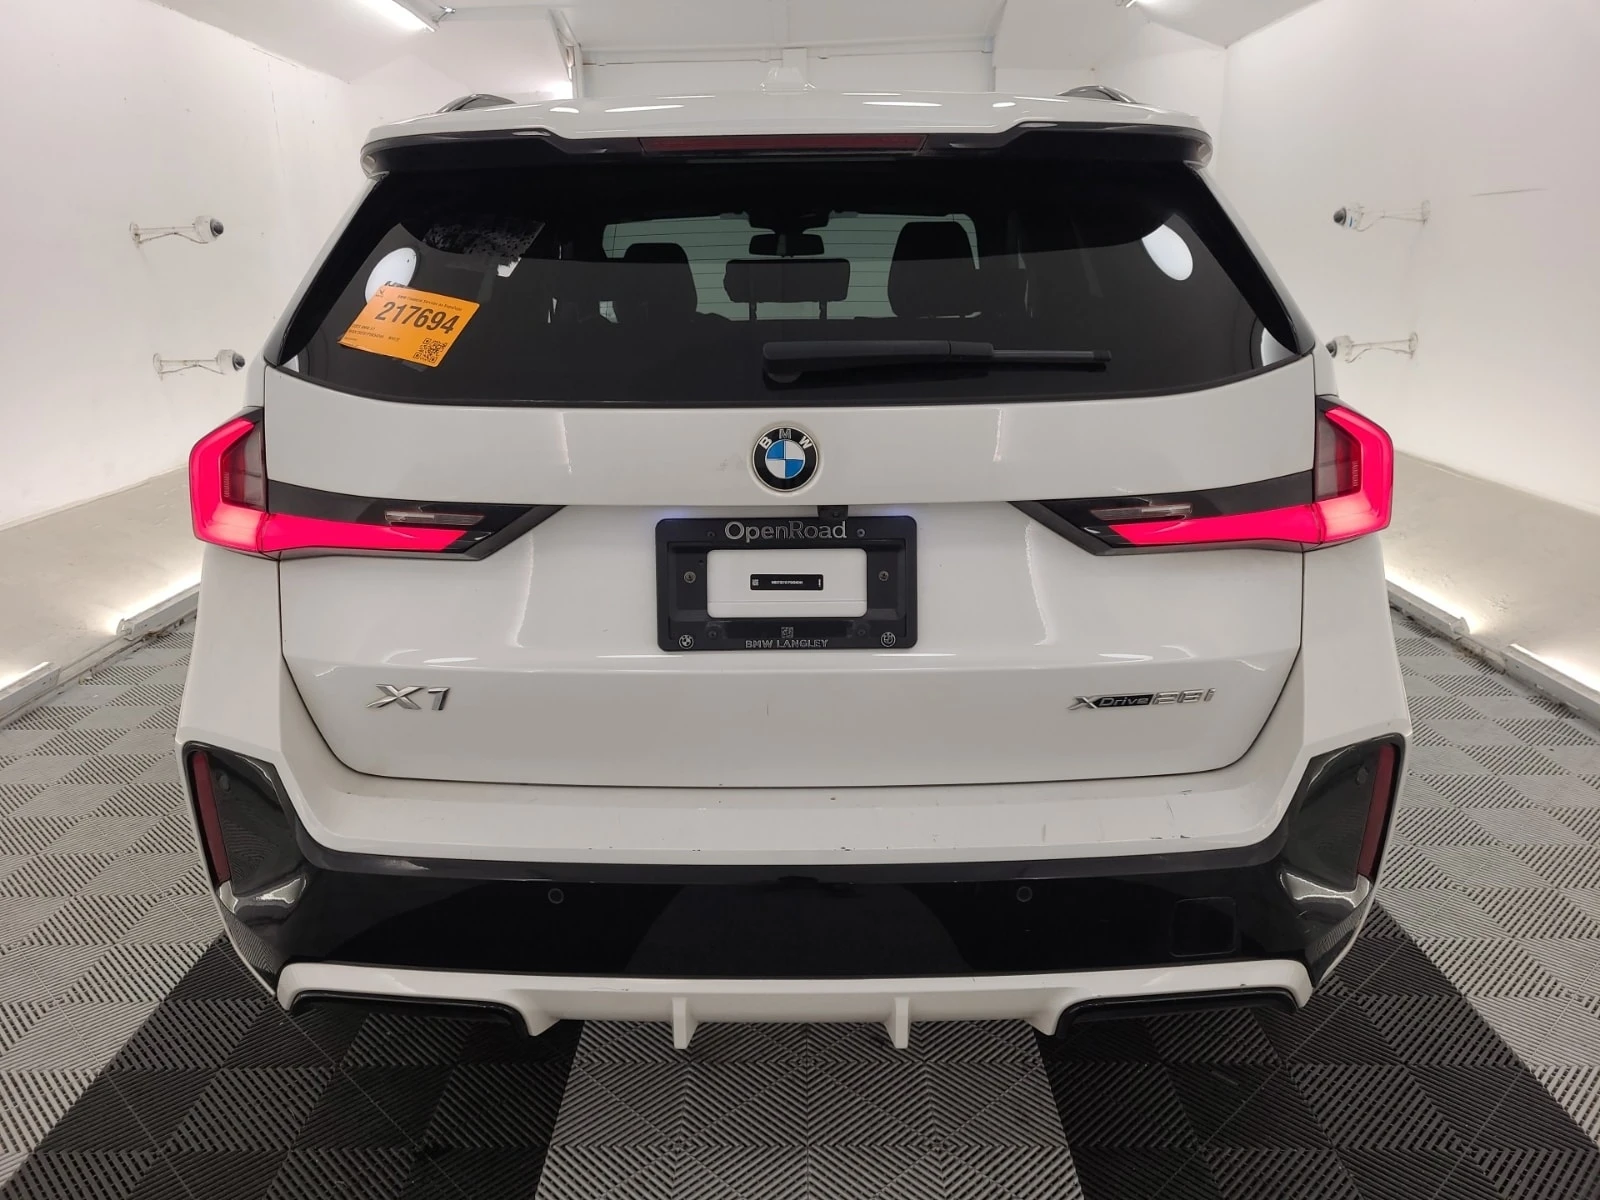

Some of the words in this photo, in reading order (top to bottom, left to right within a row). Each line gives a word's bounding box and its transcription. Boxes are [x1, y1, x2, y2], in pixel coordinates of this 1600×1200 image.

[374, 301, 460, 335] 217694
[759, 428, 813, 449] BMW
[724, 520, 847, 543] OpenRoad
[745, 639, 774, 649] BMW
[776, 639, 829, 648] LANGLEY
[365, 683, 451, 711] X1
